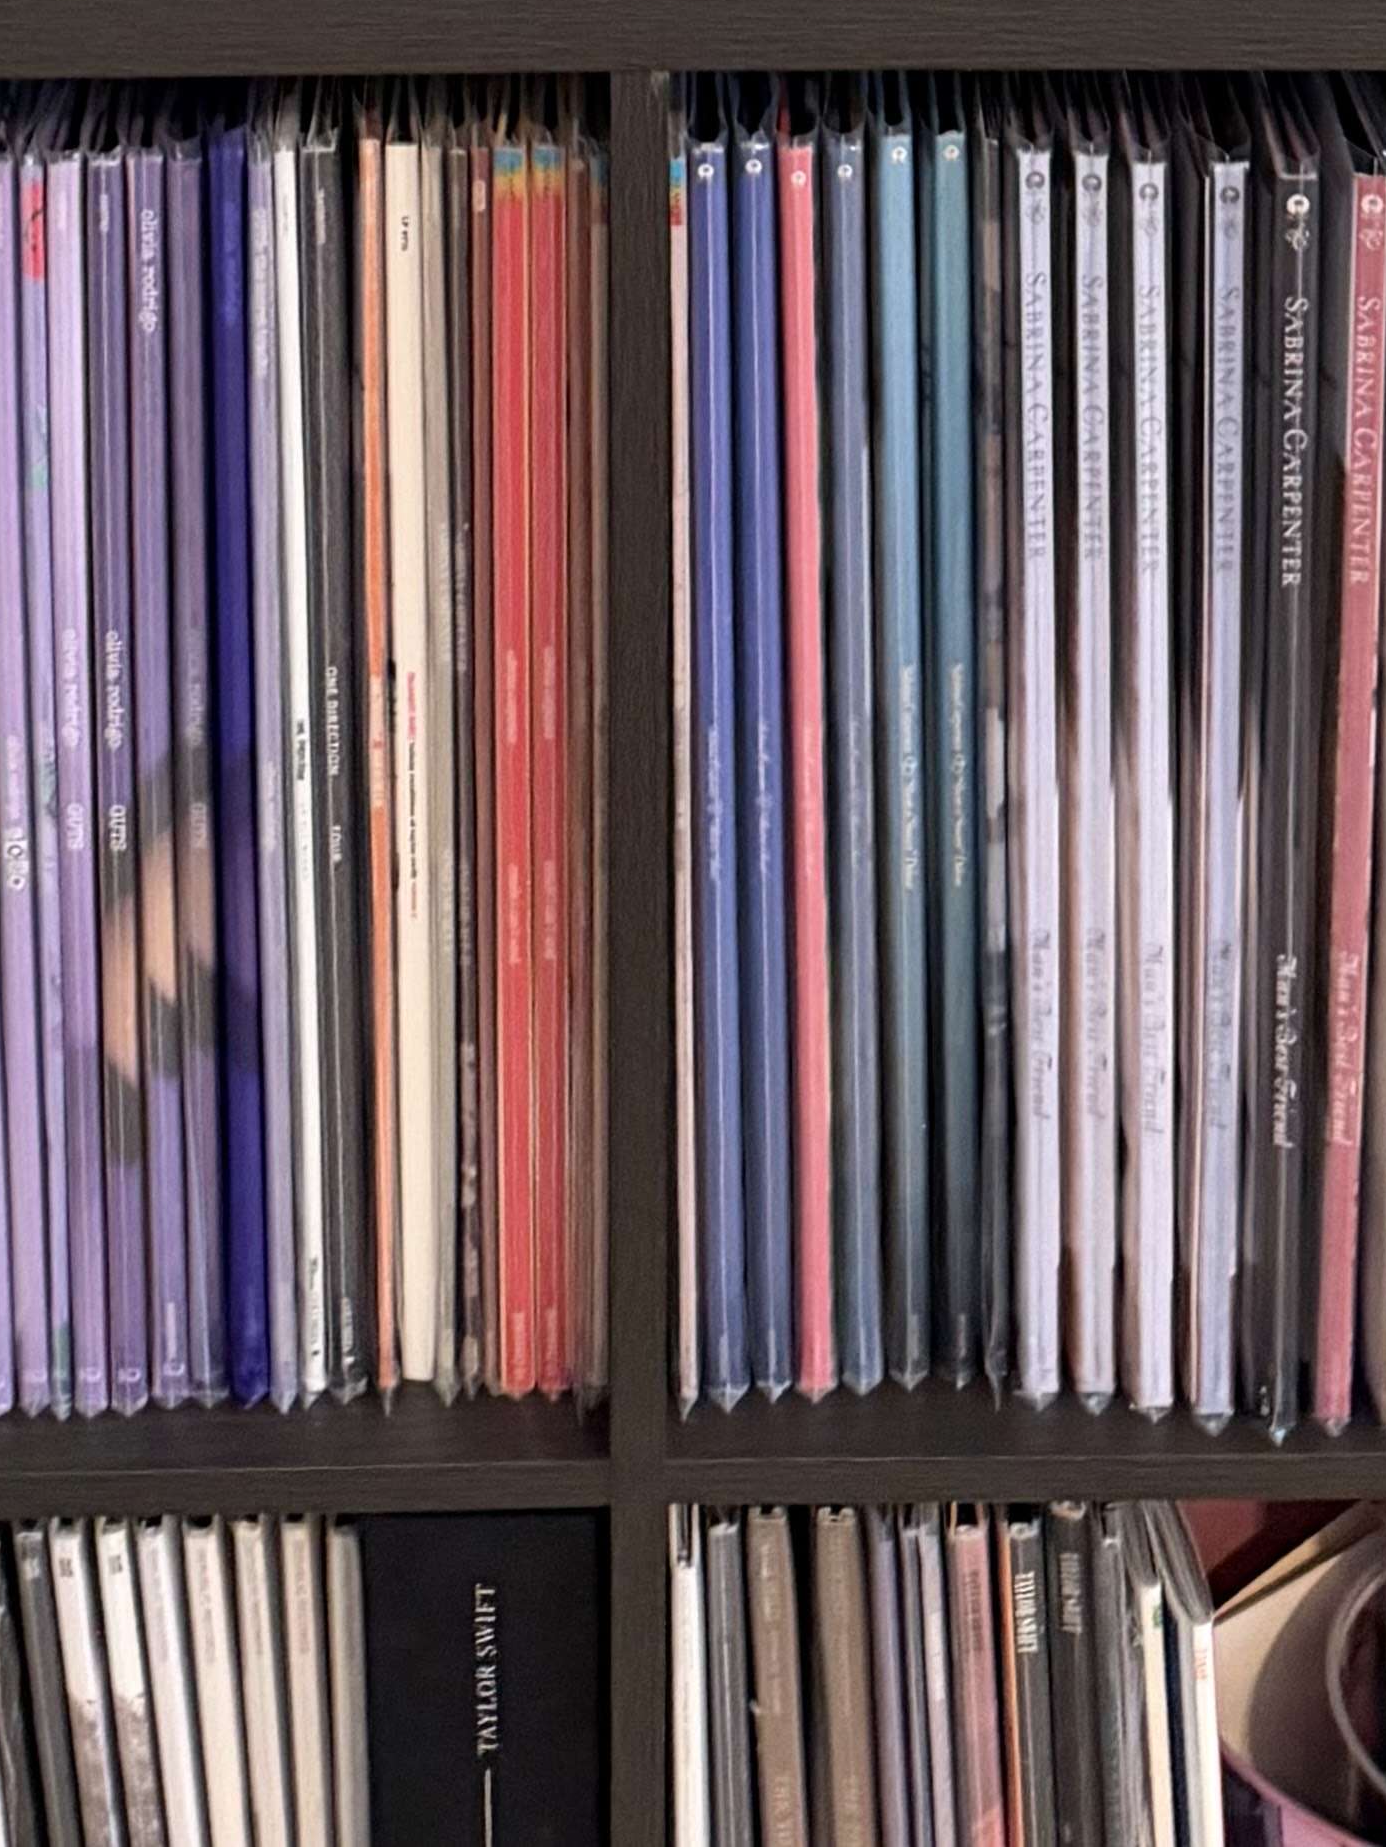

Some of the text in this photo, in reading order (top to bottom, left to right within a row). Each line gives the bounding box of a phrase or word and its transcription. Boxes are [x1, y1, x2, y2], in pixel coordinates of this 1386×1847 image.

[138, 210, 159, 334] olivia rodrigo
[1025, 272, 1048, 559] SABRINA CARPENTER
[1081, 274, 1104, 562] SABRINA CARPENTER
[1139, 284, 1162, 574] SABRINA CARPENTER
[1217, 285, 1240, 574] SABRINA CARPENTER
[1281, 296, 1308, 588] SABRINA CARPENTER
[1349, 295, 1381, 584] SABRINA CARPENTER
[103, 631, 124, 750] olivia rodrigo
[326, 666, 340, 776] ONE DIRECTION
[66, 802, 84, 851] GUTS
[108, 805, 126, 852] GUTS
[1272, 953, 1297, 1148] Man's Best Friend
[474, 1582, 499, 1755] TAYLOR SWIFT
